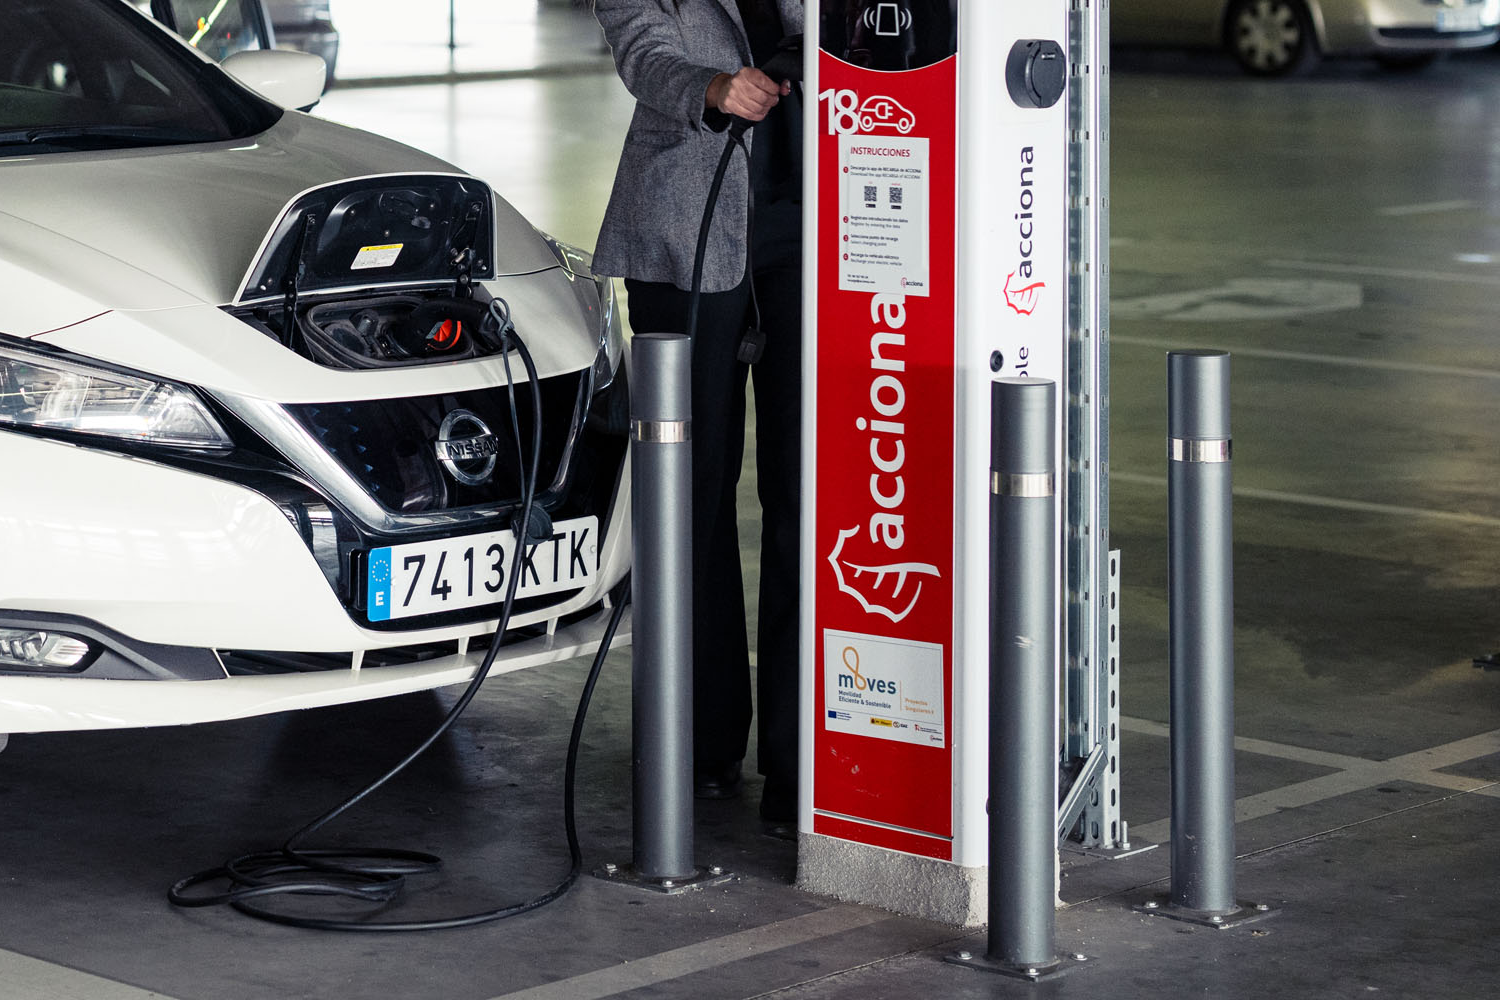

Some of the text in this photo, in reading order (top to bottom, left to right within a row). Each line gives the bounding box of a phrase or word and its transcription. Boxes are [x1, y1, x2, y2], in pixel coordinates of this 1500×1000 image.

[819, 88, 858, 135] 18
[850, 146, 910, 158] INSTRUCCIONES
[1015, 146, 1033, 278] acciona
[856, 291, 906, 549] acciona
[449, 440, 498, 456] NISSAN
[402, 527, 589, 607] 7413 KTK
[375, 591, 385, 606] E
[838, 690, 862, 698] Movilidad
[838, 696, 859, 705] Eficiente
[866, 700, 891, 709] Sostenible
